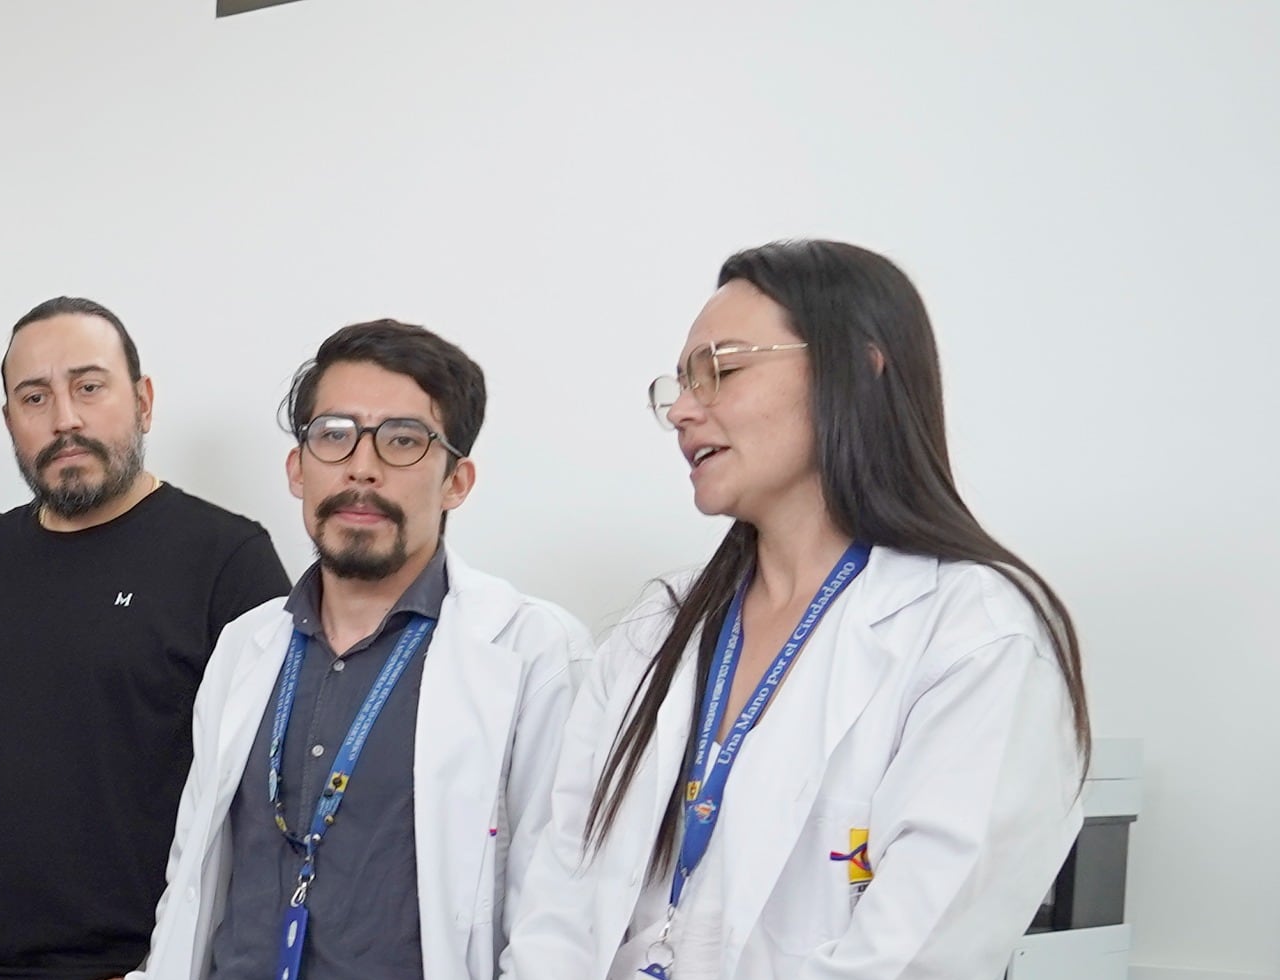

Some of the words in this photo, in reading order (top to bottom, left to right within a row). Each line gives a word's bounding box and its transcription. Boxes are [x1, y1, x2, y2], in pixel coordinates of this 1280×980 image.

[717, 733, 741, 765] Una
[736, 687, 770, 730] Mano
[766, 659, 787, 686] por
[785, 643, 799, 657] el
[793, 561, 856, 641] Ciudadano
